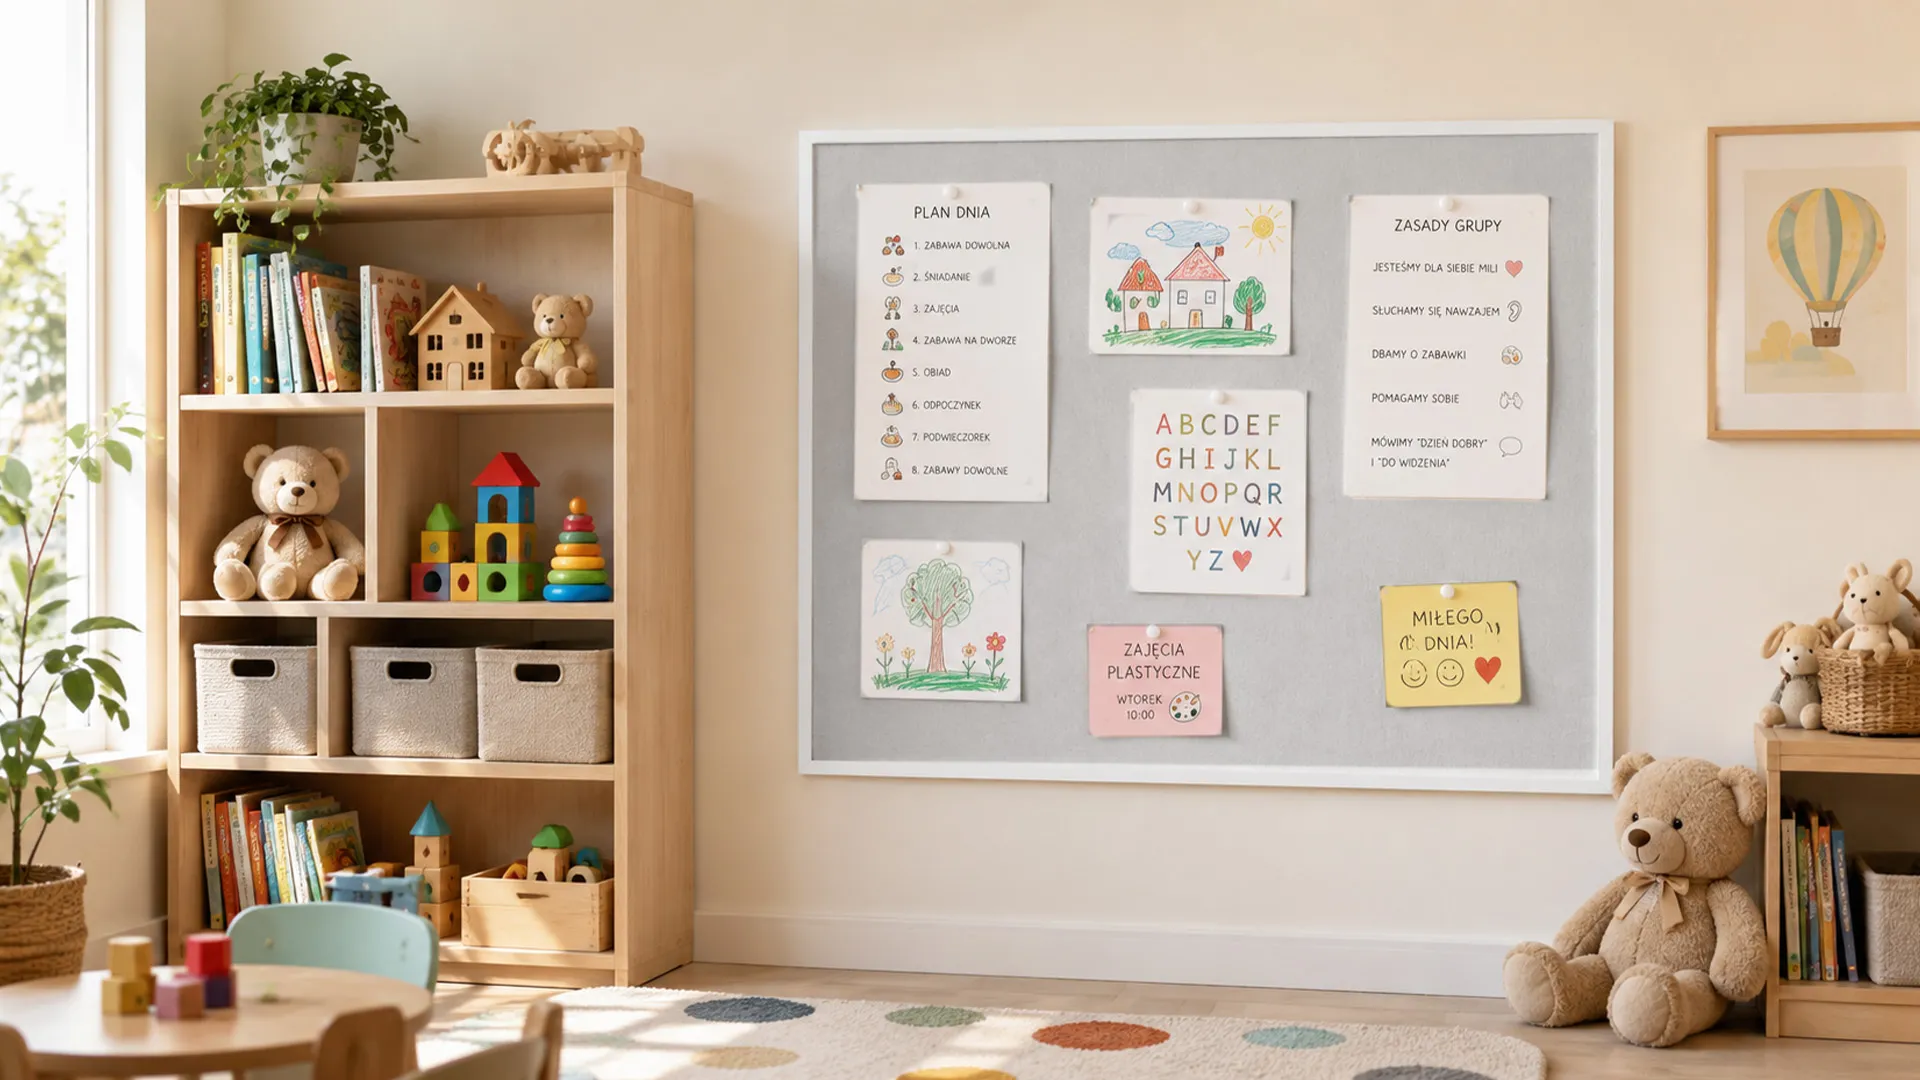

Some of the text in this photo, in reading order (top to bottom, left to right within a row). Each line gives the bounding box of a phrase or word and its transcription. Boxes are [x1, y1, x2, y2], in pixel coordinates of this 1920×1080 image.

[915, 206, 990, 219] PLAN DNIA
[1395, 219, 1501, 232] ZASADY GRUPY
[914, 241, 1010, 251] 1. ZABAWA DOWOLNA
[1373, 261, 1497, 273] JESTEŚMY DLA SIEBIE MILI
[913, 271, 970, 282] 2. ŚNIADANIE
[913, 304, 959, 315] 3. ZAJĘCIA
[1373, 306, 1500, 318] SŁUCHAMY SIĘ NAWZAJEM
[913, 336, 1016, 345] 4. ZABAWA NA DWORZE
[1372, 349, 1466, 359] DBAMY O ZABAWKI
[924, 368, 951, 377] OBIAD
[1372, 393, 1459, 403] POMAGAMY SOBIE
[912, 401, 981, 410] 6. ODPOCZYNEK
[912, 433, 990, 442] 7. PODWIECZOREK
[1372, 436, 1413, 447] MÓWIMY
[912, 466, 1007, 475] 8. ZABAWY DOWOLNE
[1413, 608, 1483, 626] MIŁEGO
[1425, 633, 1473, 651] DNIA!
[1124, 643, 1184, 659] ZAJĘCIA
[1108, 665, 1200, 679] PLASTYCZNE
[1117, 694, 1162, 704] WTOREK
[1127, 709, 1154, 720] 10:00
